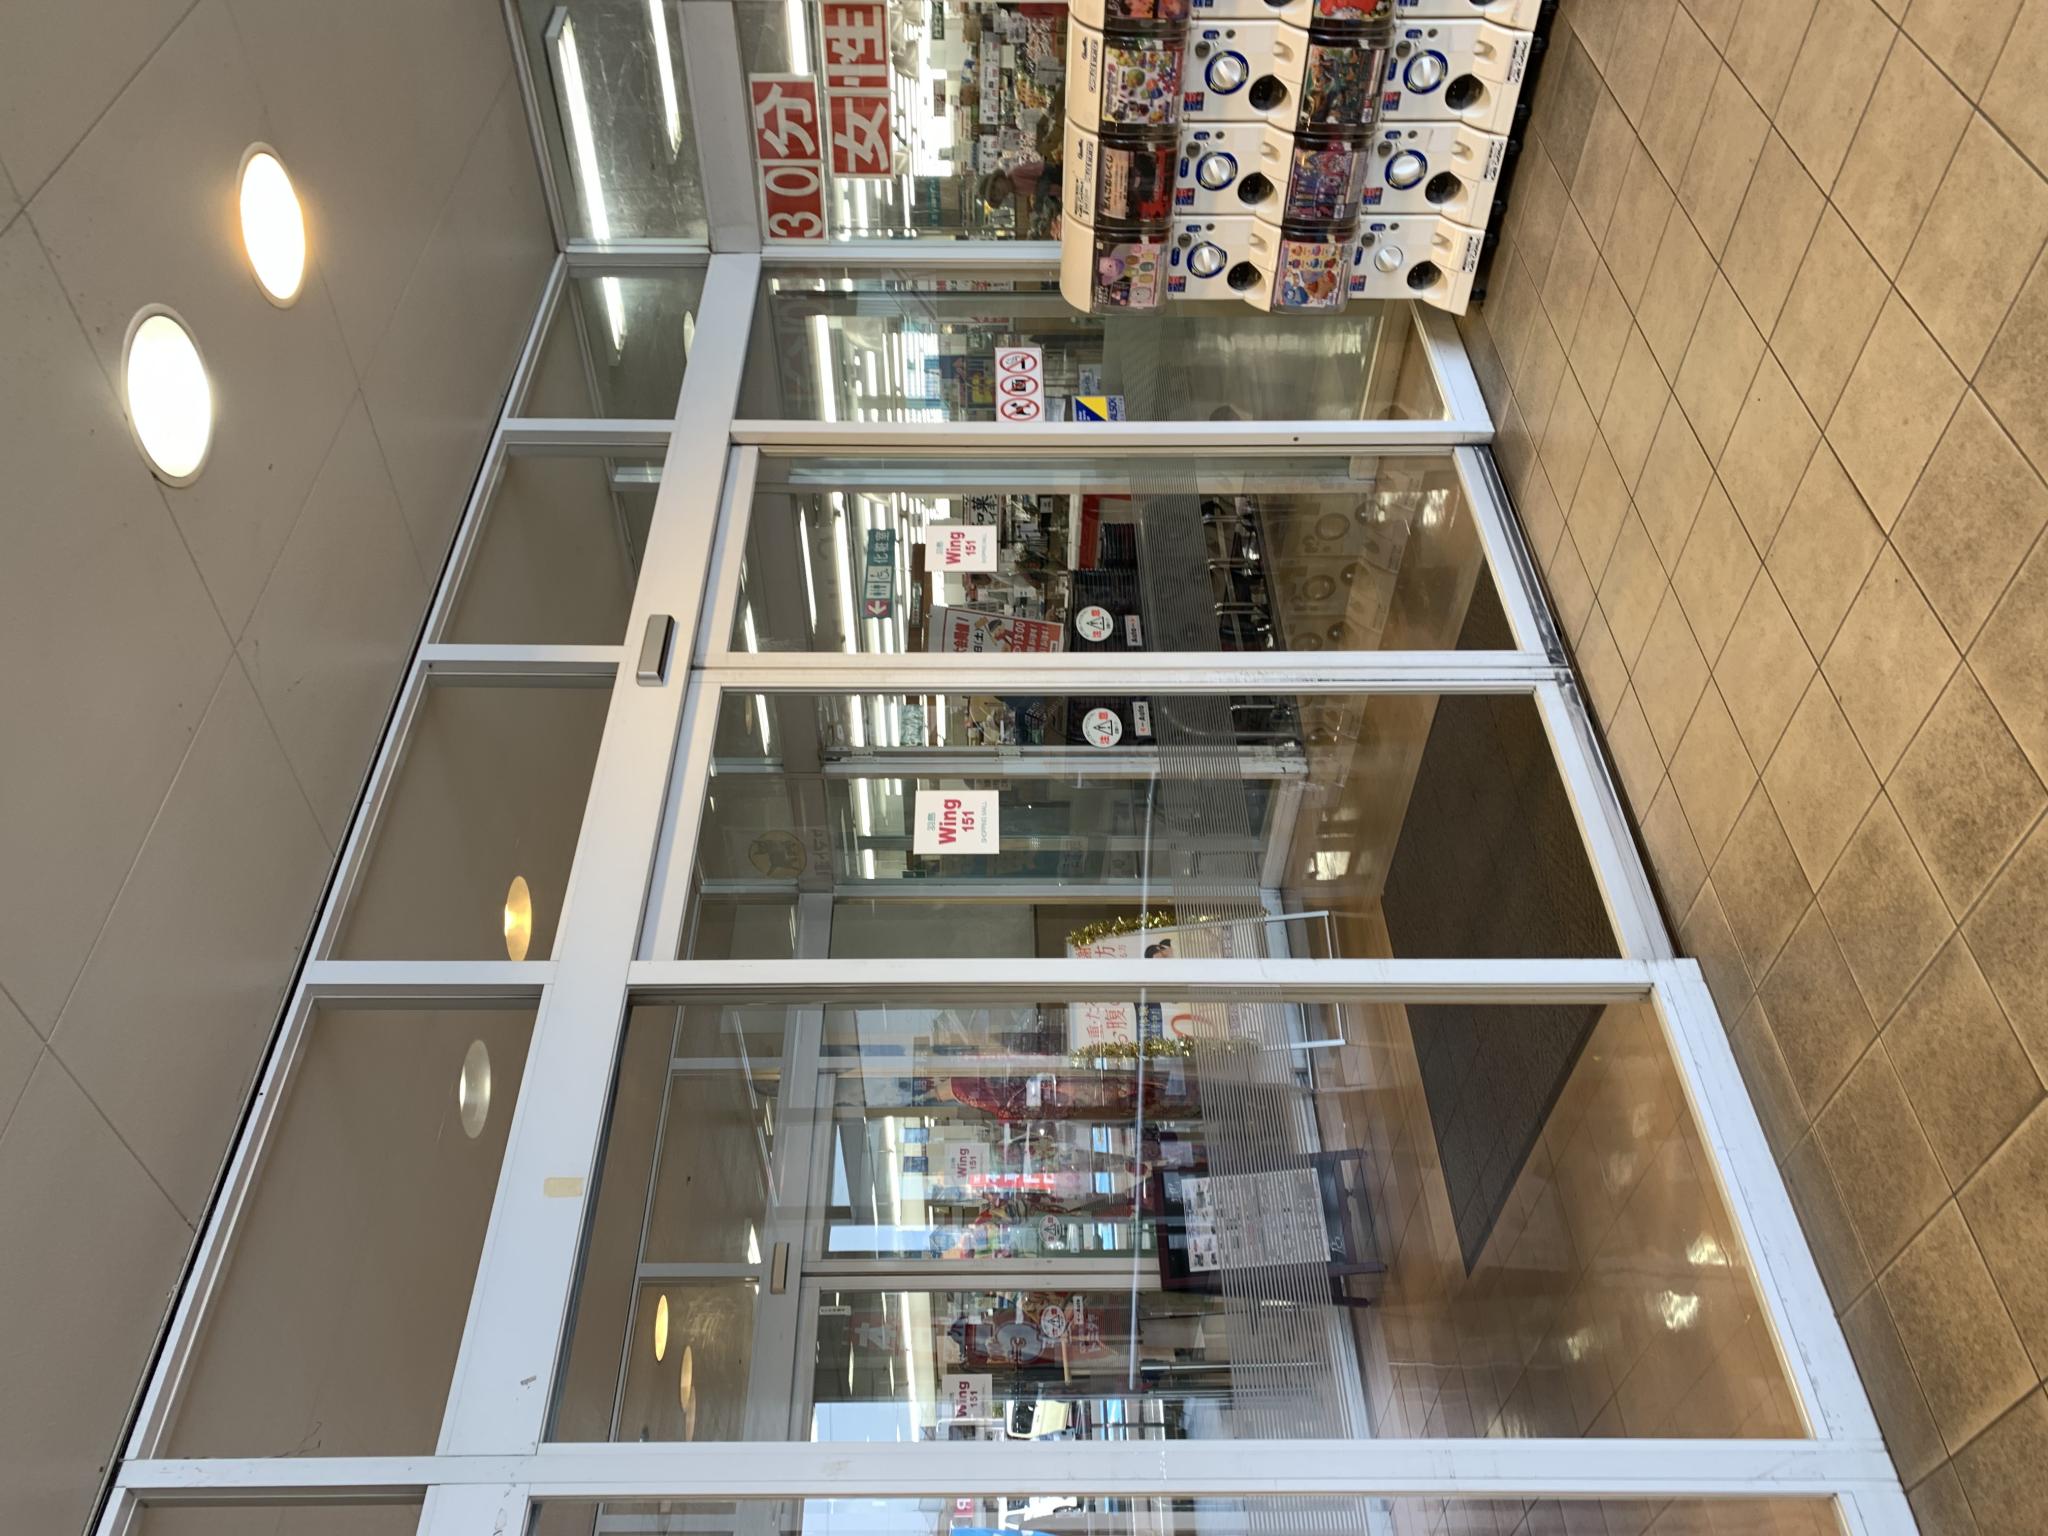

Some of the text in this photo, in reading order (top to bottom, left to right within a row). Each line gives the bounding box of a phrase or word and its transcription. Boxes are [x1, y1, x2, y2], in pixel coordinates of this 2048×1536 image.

[824, 5, 889, 172] 女性
[754, 82, 823, 237] 30分
[946, 532, 965, 564] Wing
[964, 540, 976, 556] 151
[1137, 704, 1146, 721] Auto
[938, 798, 962, 844] Wing
[962, 811, 974, 832] 151
[956, 1148, 970, 1178] Wing
[956, 1381, 970, 1418] Wing
[970, 1390, 978, 1408] 151
